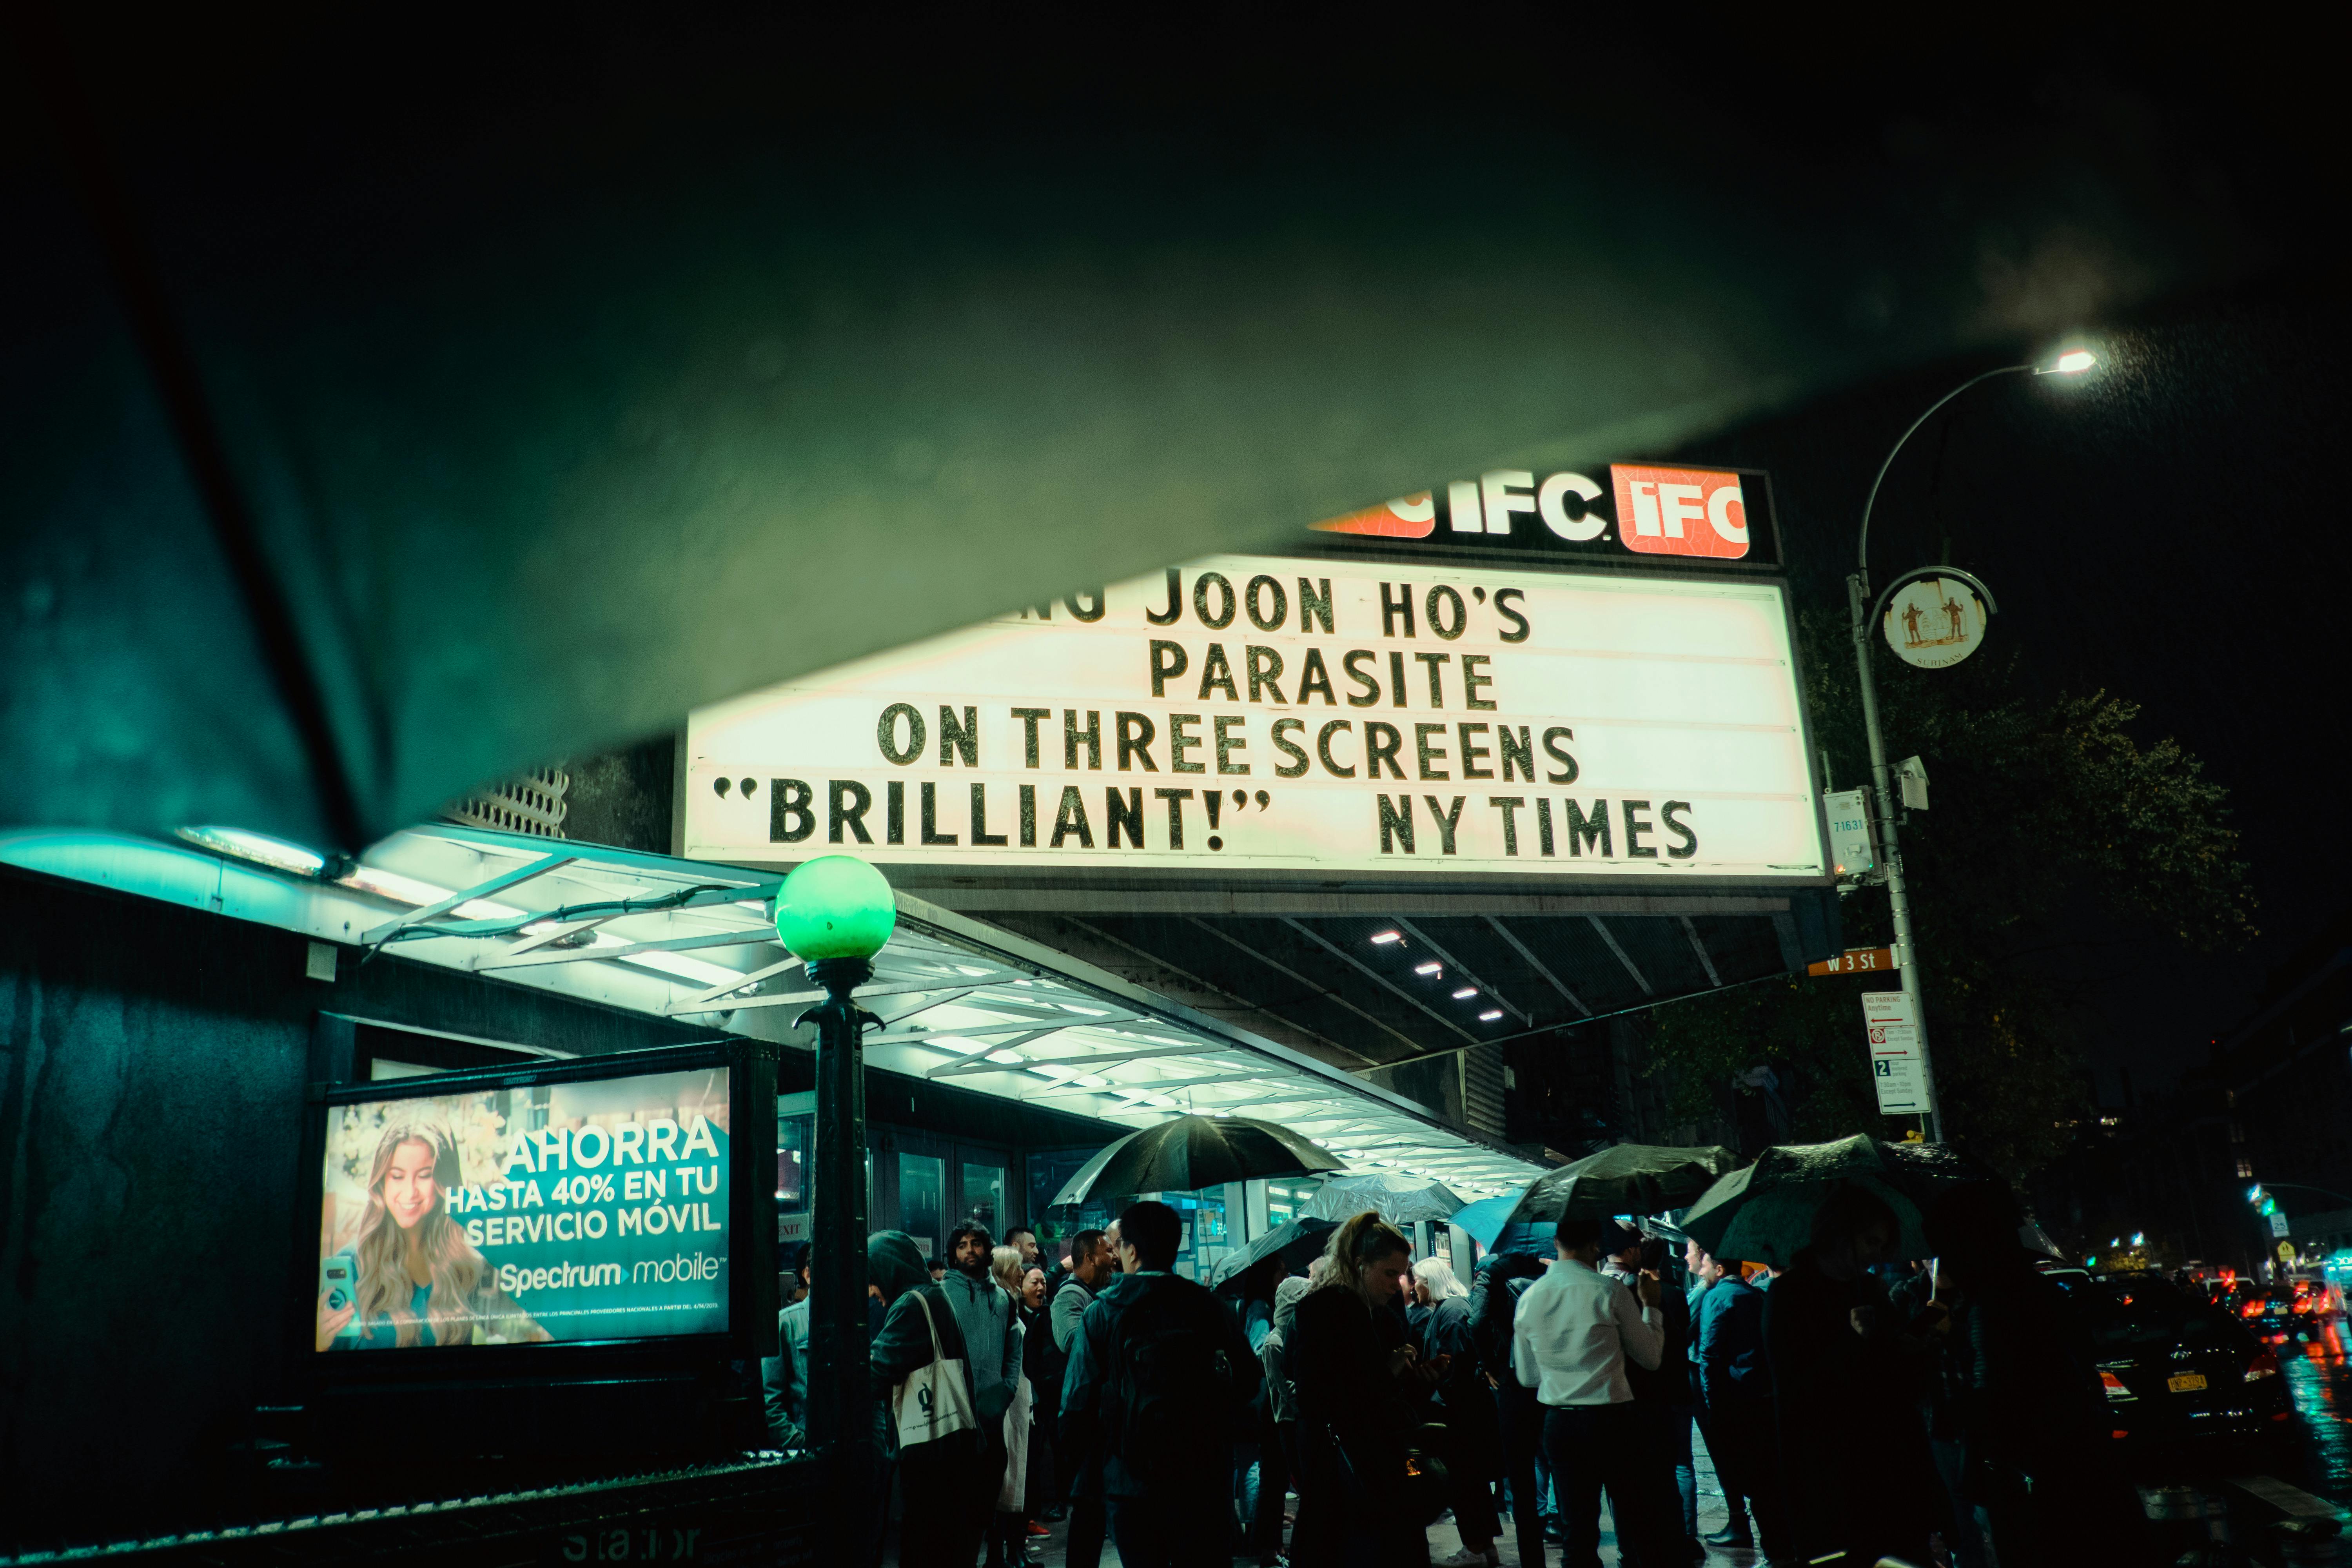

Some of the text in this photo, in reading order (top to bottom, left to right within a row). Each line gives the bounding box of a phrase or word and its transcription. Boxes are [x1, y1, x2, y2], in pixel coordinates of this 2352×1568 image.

[1146, 565, 1334, 633] JOON
[1380, 583, 1530, 642] HO'S
[1150, 640, 1497, 710] PARASITE
[1916, 653, 1963, 666] SURINAM
[878, 703, 1579, 783] ON THREE SCREENS
[1377, 794, 1466, 855] NY
[1489, 797, 1697, 858] TIMES
[1827, 953, 1876, 971] W 3 St
[1878, 1061, 1887, 1075] 2
[503, 1114, 719, 1175] AHORRA
[445, 1165, 718, 1214] HASTA 40% EN TU
[466, 1198, 721, 1247] SERVICIO MÓVIL
[500, 1261, 621, 1298] Spectrum
